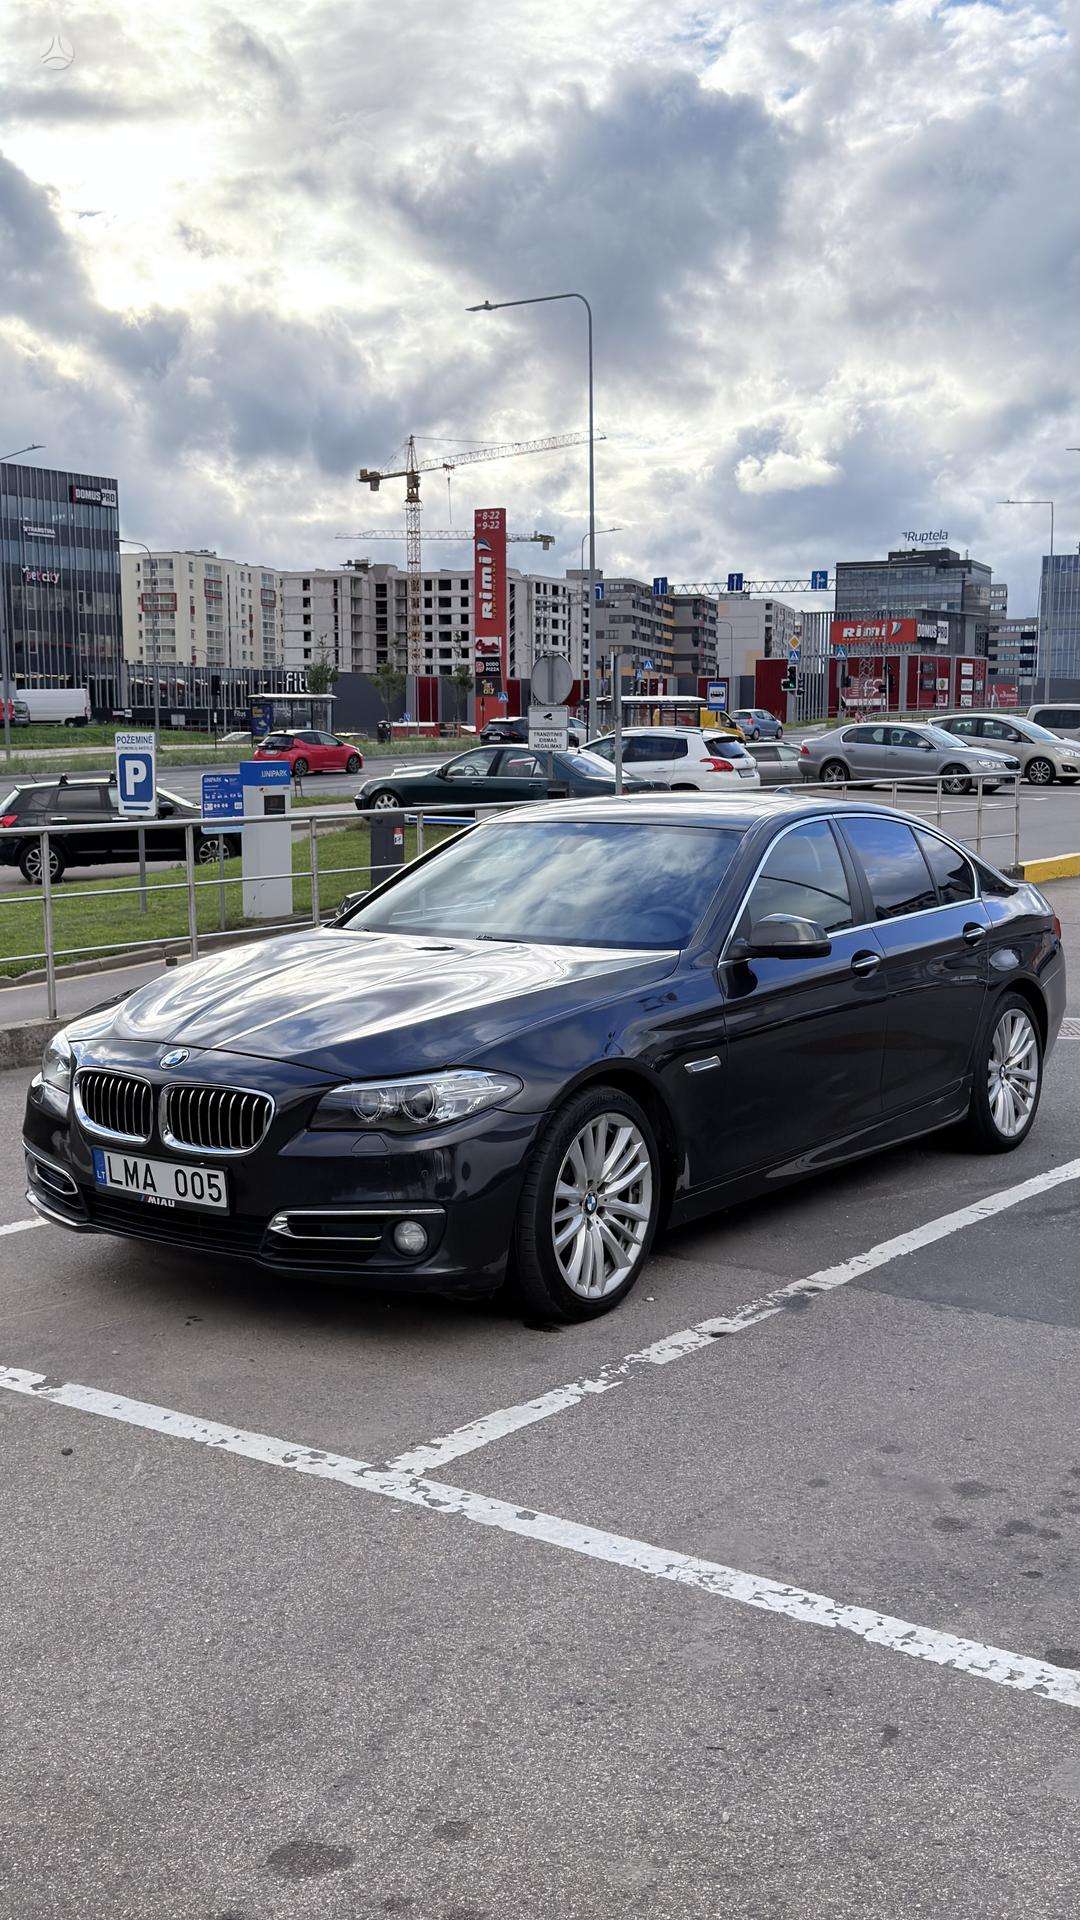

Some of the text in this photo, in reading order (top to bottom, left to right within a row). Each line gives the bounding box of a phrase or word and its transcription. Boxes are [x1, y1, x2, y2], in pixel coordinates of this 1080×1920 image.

[75, 488, 115, 503] DOMUS PRO
[482, 511, 500, 520] 8-22
[482, 521, 500, 530] 9-22
[907, 530, 949, 544] Ruptela
[116, 733, 153, 744] POŽEMINĖ
[125, 760, 147, 796] P
[96, 1155, 222, 1203] LT LMA 005
